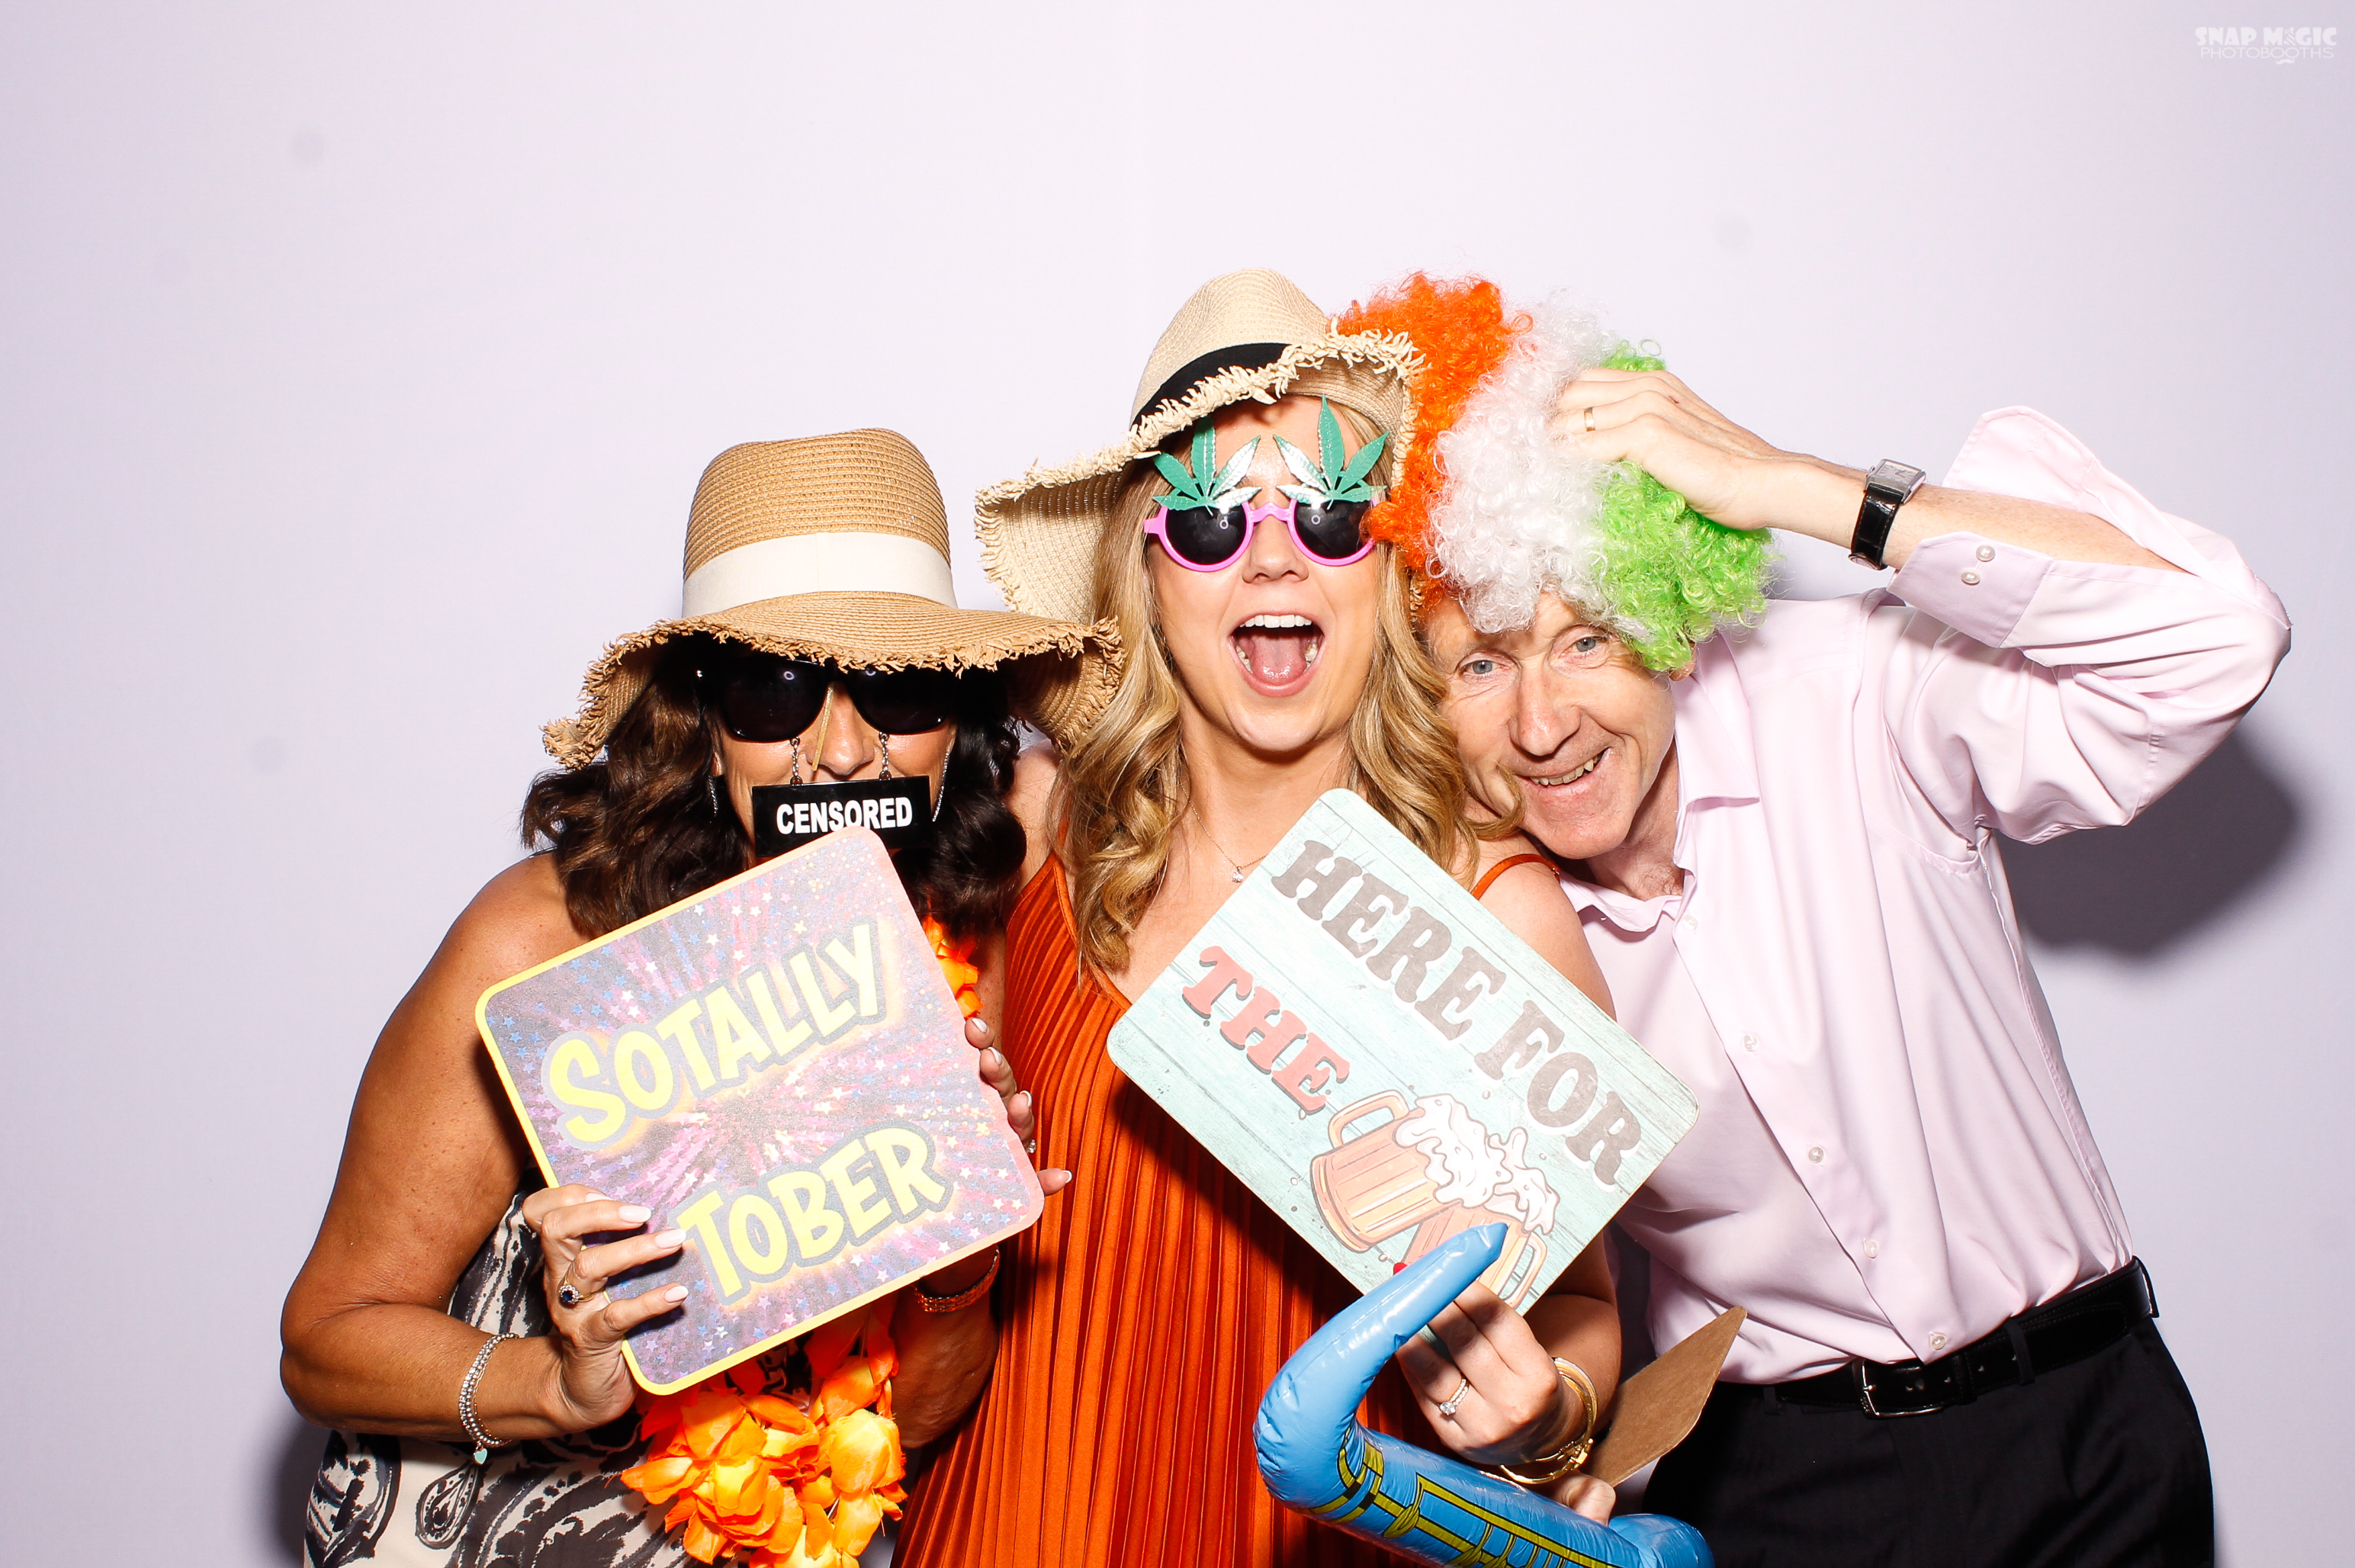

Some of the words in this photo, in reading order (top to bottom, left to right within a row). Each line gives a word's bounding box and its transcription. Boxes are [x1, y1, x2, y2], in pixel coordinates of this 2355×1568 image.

[776, 797, 913, 834] CENSORED
[545, 921, 885, 1148] SOTALLY
[1182, 946, 1351, 1115] THE
[1271, 840, 1506, 1043] HERE
[1473, 1001, 1642, 1187] FOR
[673, 1125, 950, 1300] TOBER
